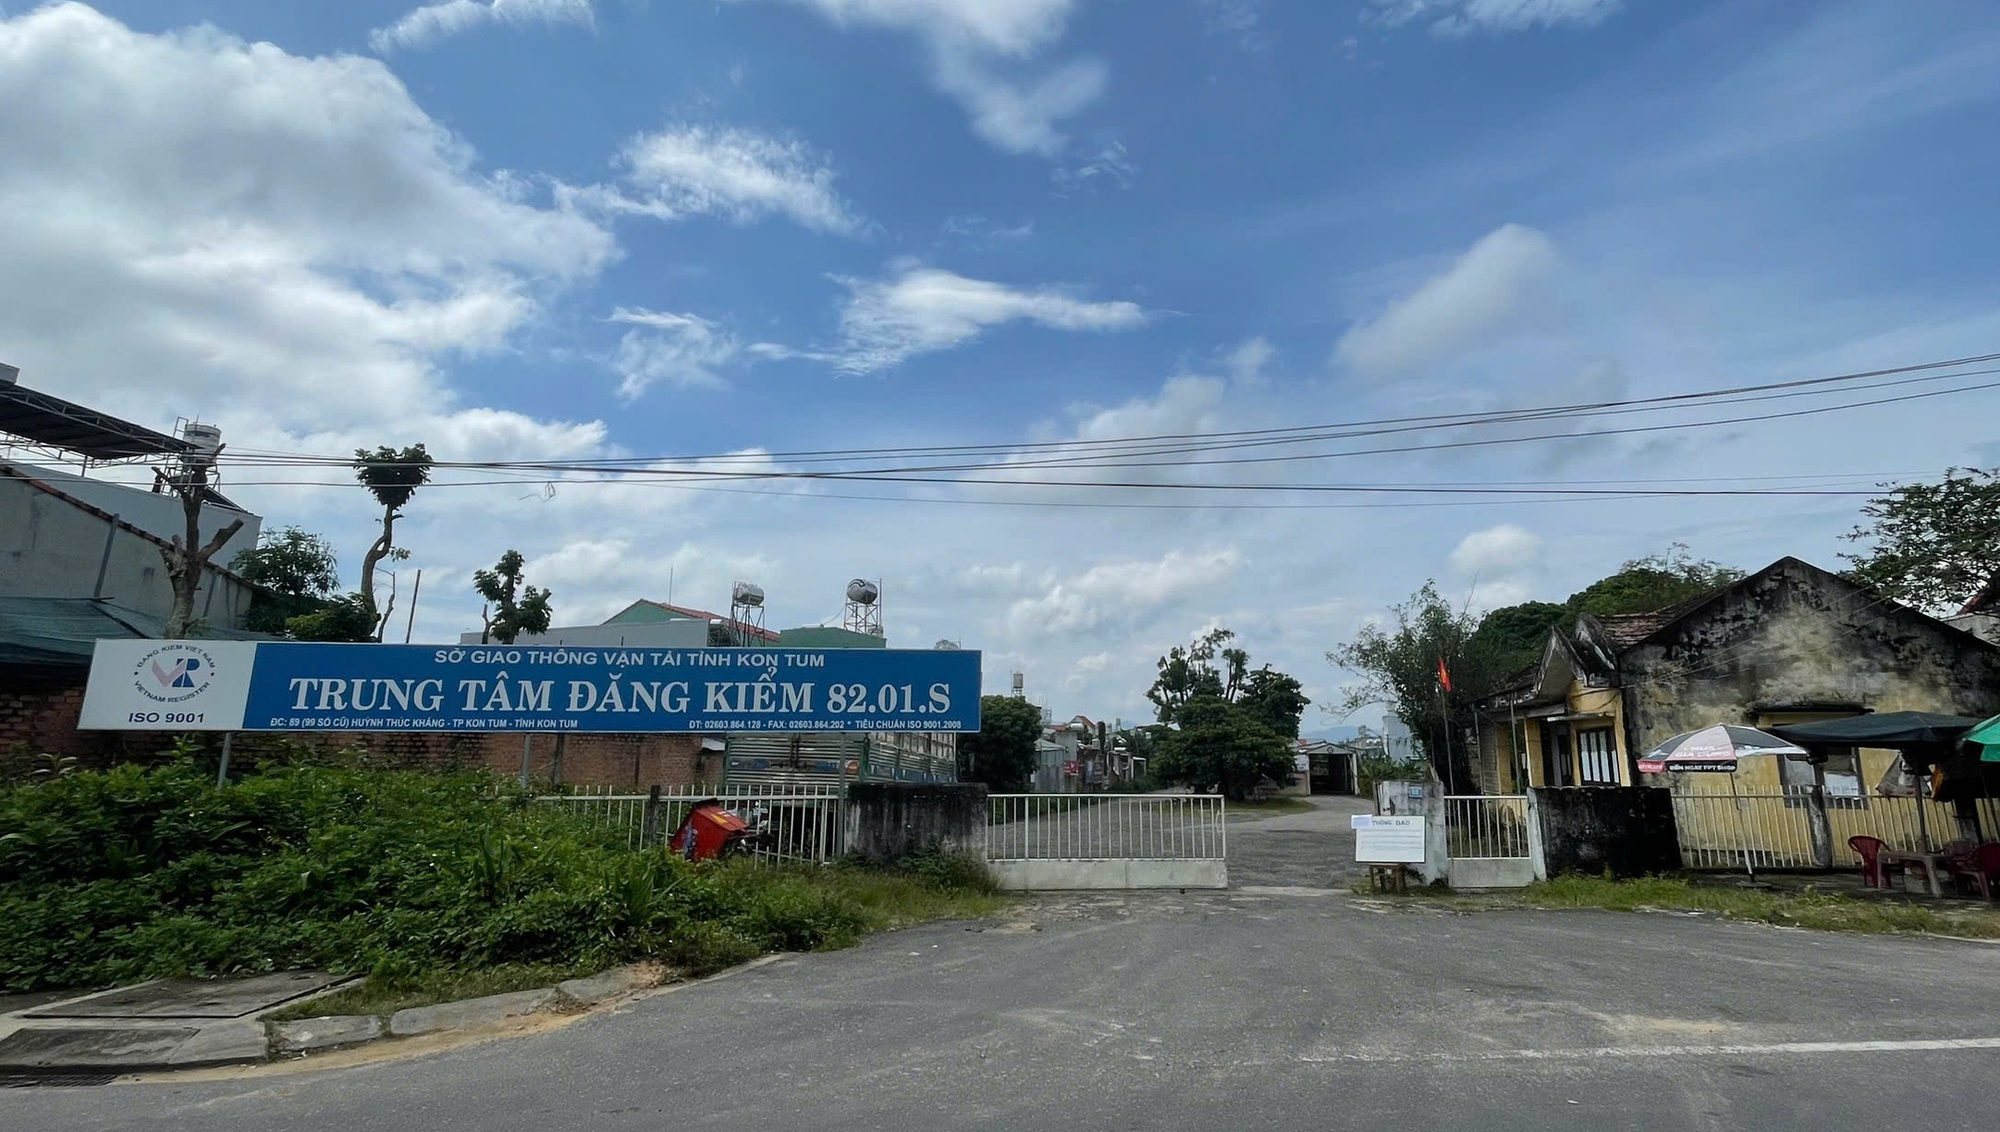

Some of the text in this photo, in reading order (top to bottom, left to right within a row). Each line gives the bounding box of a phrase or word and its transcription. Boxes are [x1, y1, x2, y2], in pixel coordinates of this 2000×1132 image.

[434, 647, 825, 668] SỞ GIAO THÔNG VẬN TẢI TỈNH KON TUM
[134, 680, 210, 703] VIETNAM REGISTER
[289, 667, 952, 713] TRUNG TÂM ĐĂNG KIỂM 82.01.S
[128, 712, 205, 723] ISO 9001
[270, 717, 288, 727] ĐC:
[301, 717, 316, 728] (99
[385, 717, 411, 728] THÚC
[452, 718, 465, 728] TP
[465, 718, 486, 728] KON
[488, 718, 508, 728] TUM
[537, 719, 557, 728] KON
[559, 719, 579, 728] TUM
[768, 720, 787, 729] FAX:
[907, 720, 922, 729] ISO
